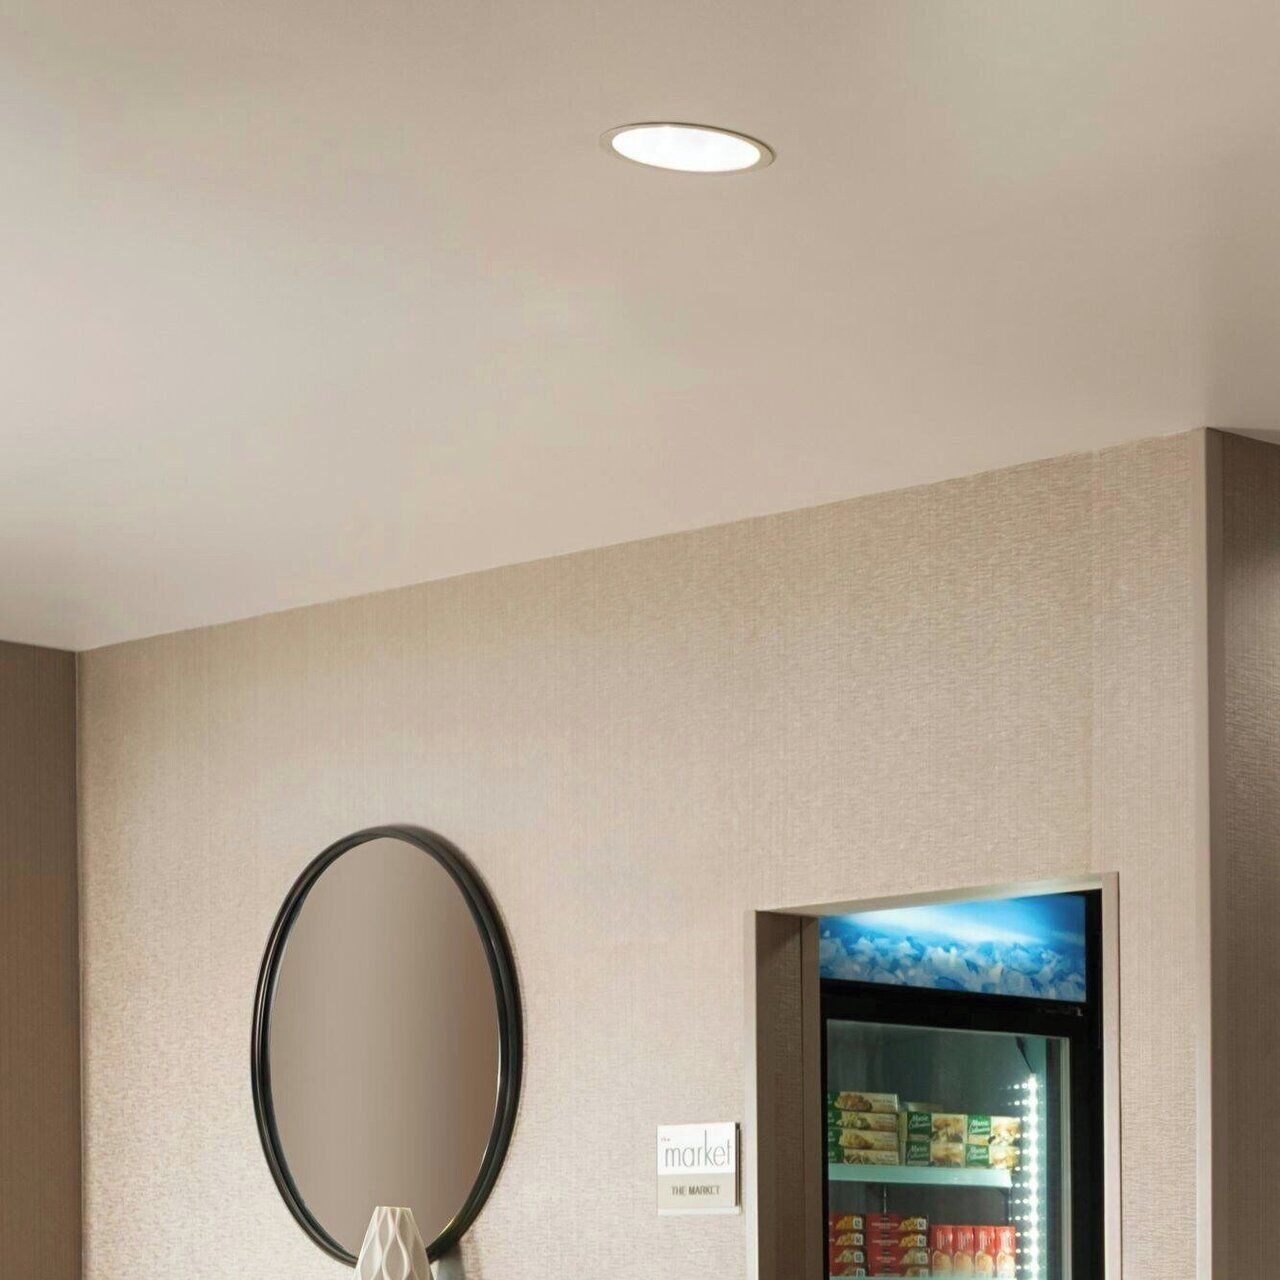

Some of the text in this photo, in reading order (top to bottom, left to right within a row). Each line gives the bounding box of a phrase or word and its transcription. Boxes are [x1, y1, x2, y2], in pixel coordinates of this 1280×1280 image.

[665, 1129, 732, 1168] market
[672, 1185, 721, 1196] THE MARKET
